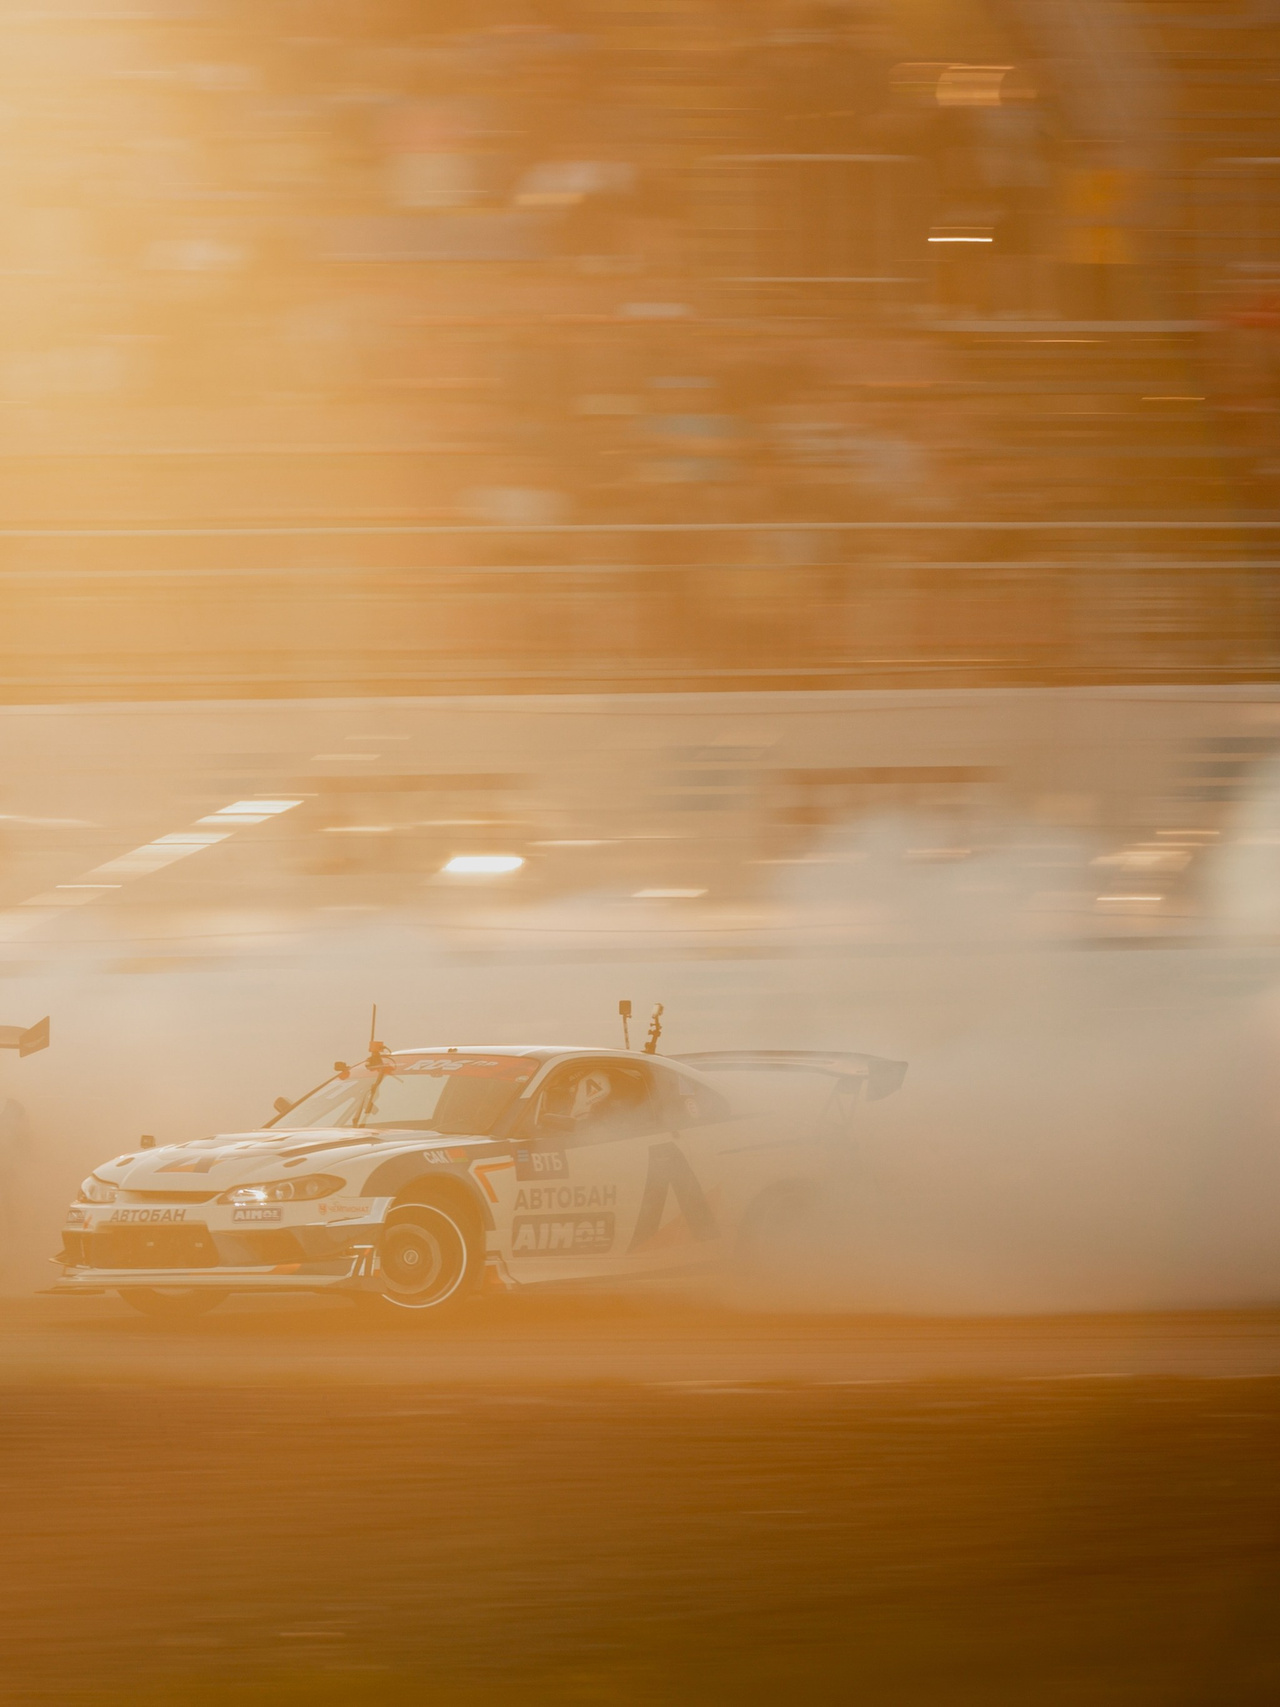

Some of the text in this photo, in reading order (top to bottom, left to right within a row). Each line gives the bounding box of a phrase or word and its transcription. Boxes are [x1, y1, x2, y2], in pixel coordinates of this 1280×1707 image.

[404, 1059, 472, 1071] RDS
[530, 1152, 563, 1172] ВТБ
[514, 1185, 617, 1211] АВТОБАН
[109, 1208, 187, 1223] АВТОБАН
[234, 1209, 280, 1221] AIMOL
[512, 1220, 612, 1250] AIMOL
